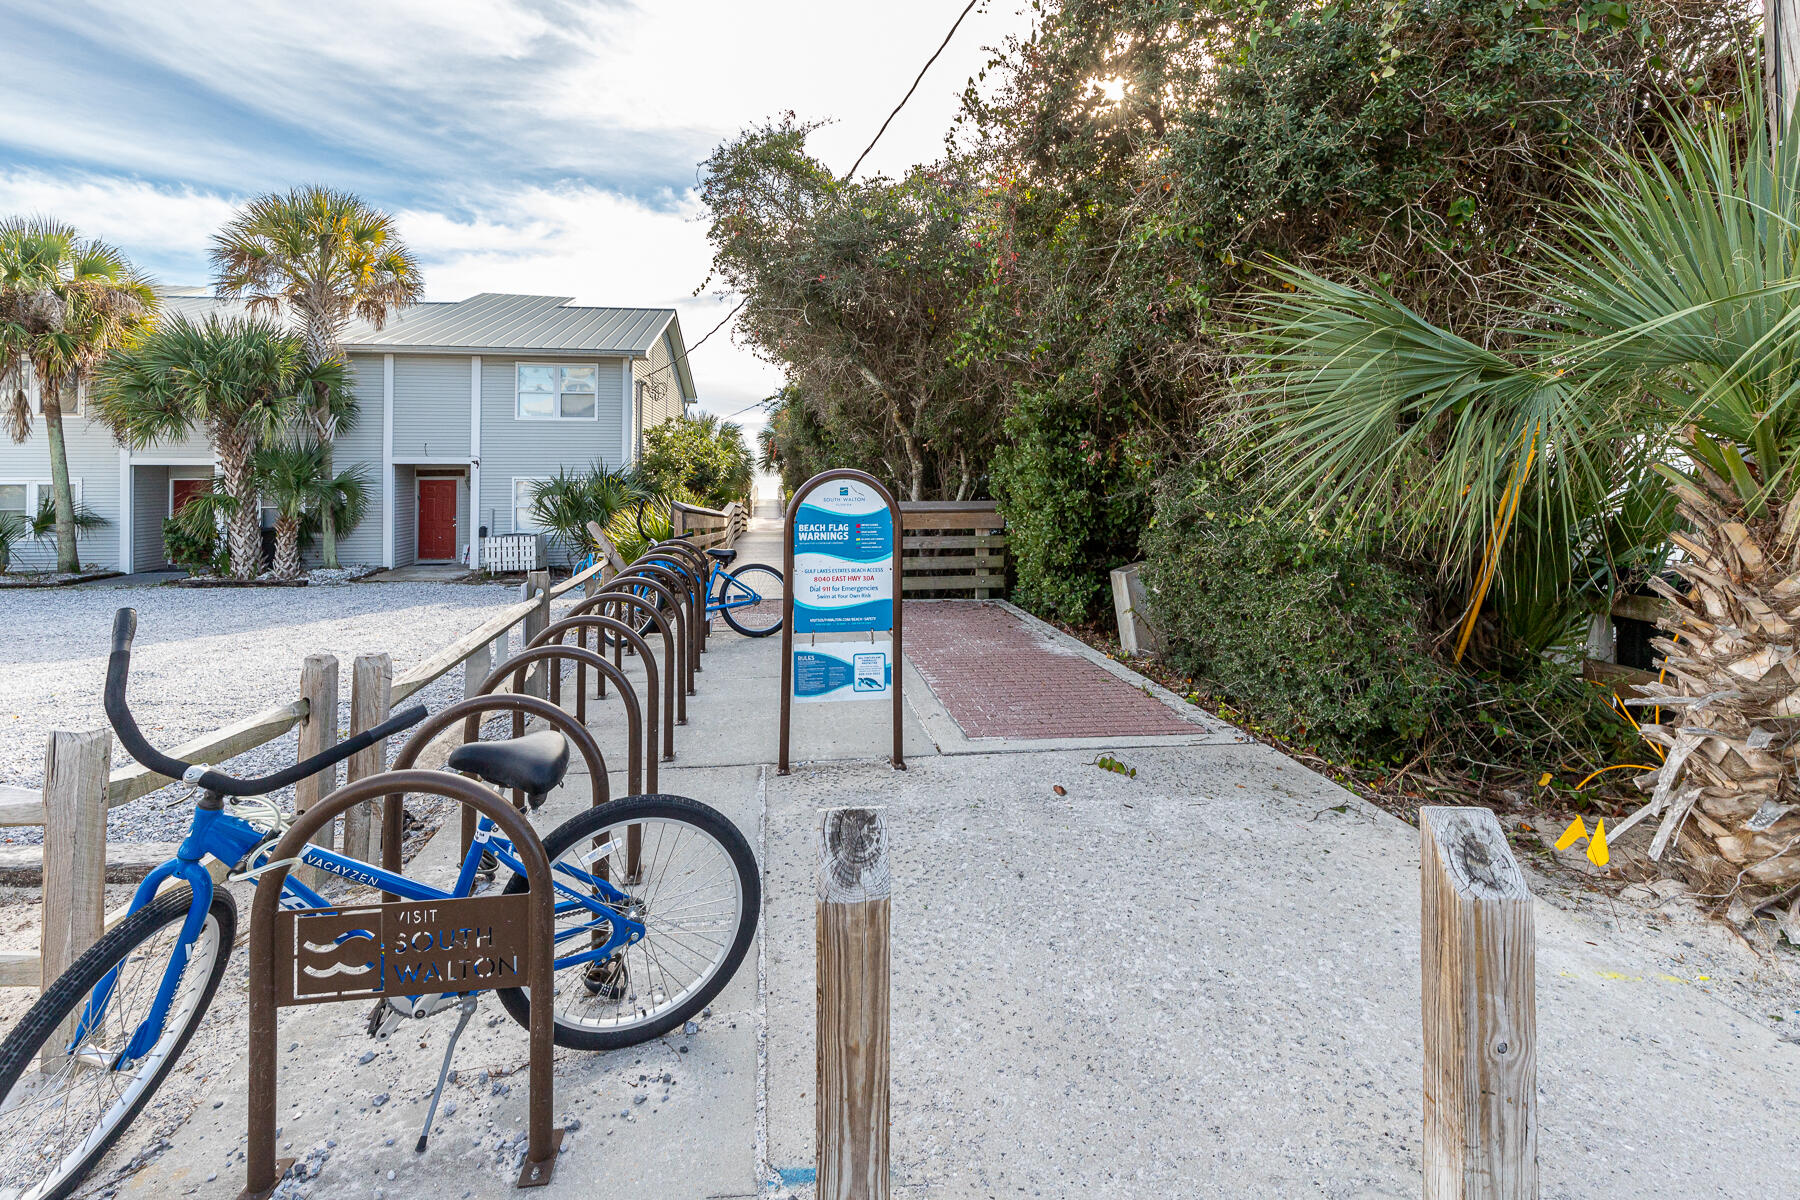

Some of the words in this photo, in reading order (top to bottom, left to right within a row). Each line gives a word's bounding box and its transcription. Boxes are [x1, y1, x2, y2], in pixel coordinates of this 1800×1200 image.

[799, 524, 825, 532] BEACH
[829, 523, 849, 531] FLAG
[799, 532, 849, 541] WARNINGS
[841, 585, 878, 593] Emergencies
[307, 854, 379, 886] VACAYZEN
[395, 909, 438, 924] VISIT
[395, 926, 493, 955] SOUTH
[394, 954, 518, 985] WALTON
